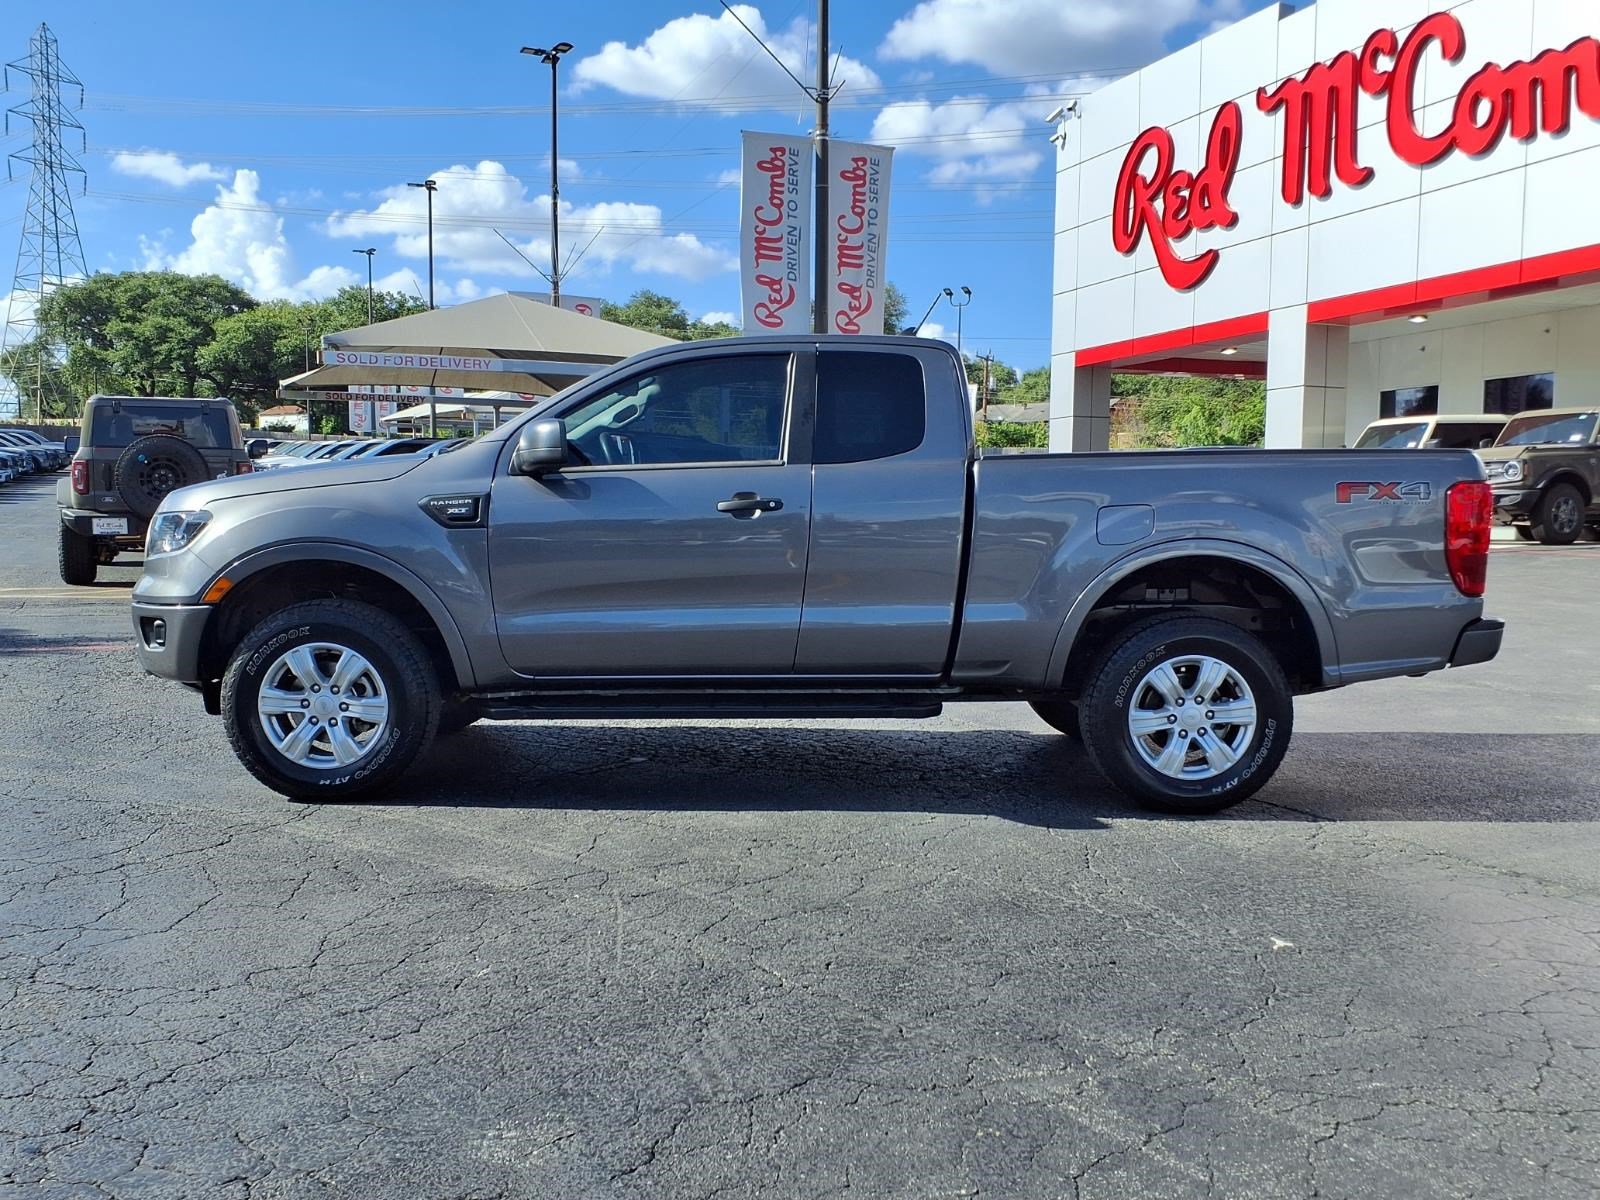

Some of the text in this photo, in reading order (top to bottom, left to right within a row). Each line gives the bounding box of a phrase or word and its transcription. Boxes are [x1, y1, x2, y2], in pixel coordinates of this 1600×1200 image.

[754, 147, 795, 328] Red McCombs
[787, 147, 799, 282] DRIVEN TO SERVE
[835, 156, 873, 334] Red McCombs
[866, 158, 880, 289] DRIVEN TO SERVE
[1113, 102, 1242, 290] Red
[325, 392, 426, 403] SOLD FOR DELIVERY
[336, 352, 492, 370] SOLD FOR DELIVERY
[1335, 481, 1431, 504] FX4
